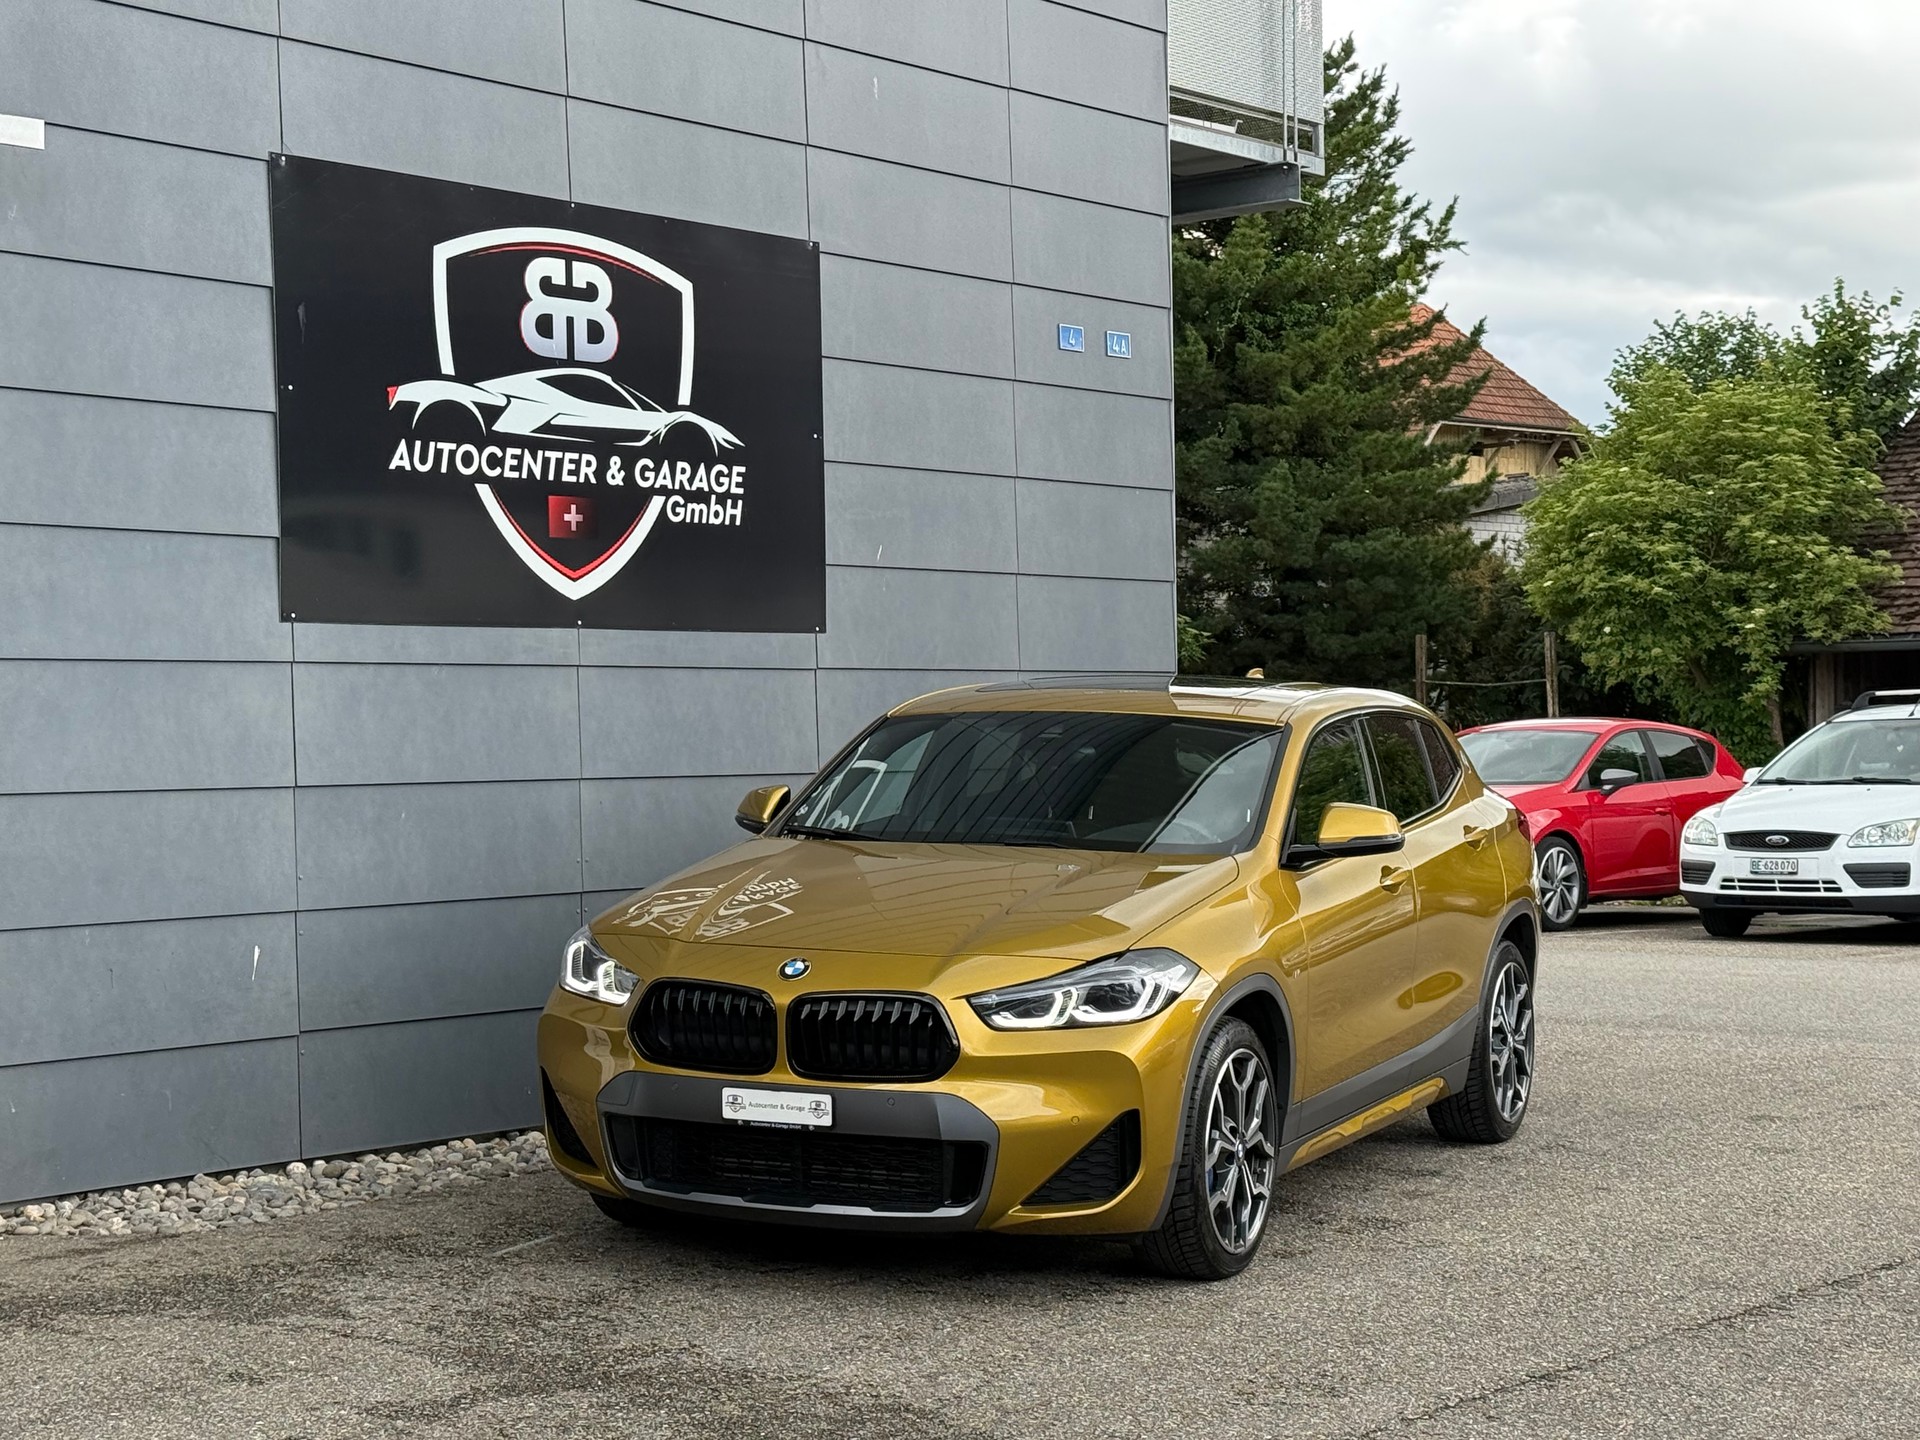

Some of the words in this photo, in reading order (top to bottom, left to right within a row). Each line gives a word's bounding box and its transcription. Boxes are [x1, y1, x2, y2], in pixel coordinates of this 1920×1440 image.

[1068, 328, 1076, 346] 4
[1112, 335, 1127, 354] 4A
[388, 438, 598, 485] AUTOCENTER
[606, 455, 626, 487] &
[634, 458, 747, 495] GARAGE
[666, 494, 744, 526] GmbH
[748, 1101, 779, 1110] Autocenter
[786, 1104, 806, 1112] Garage
